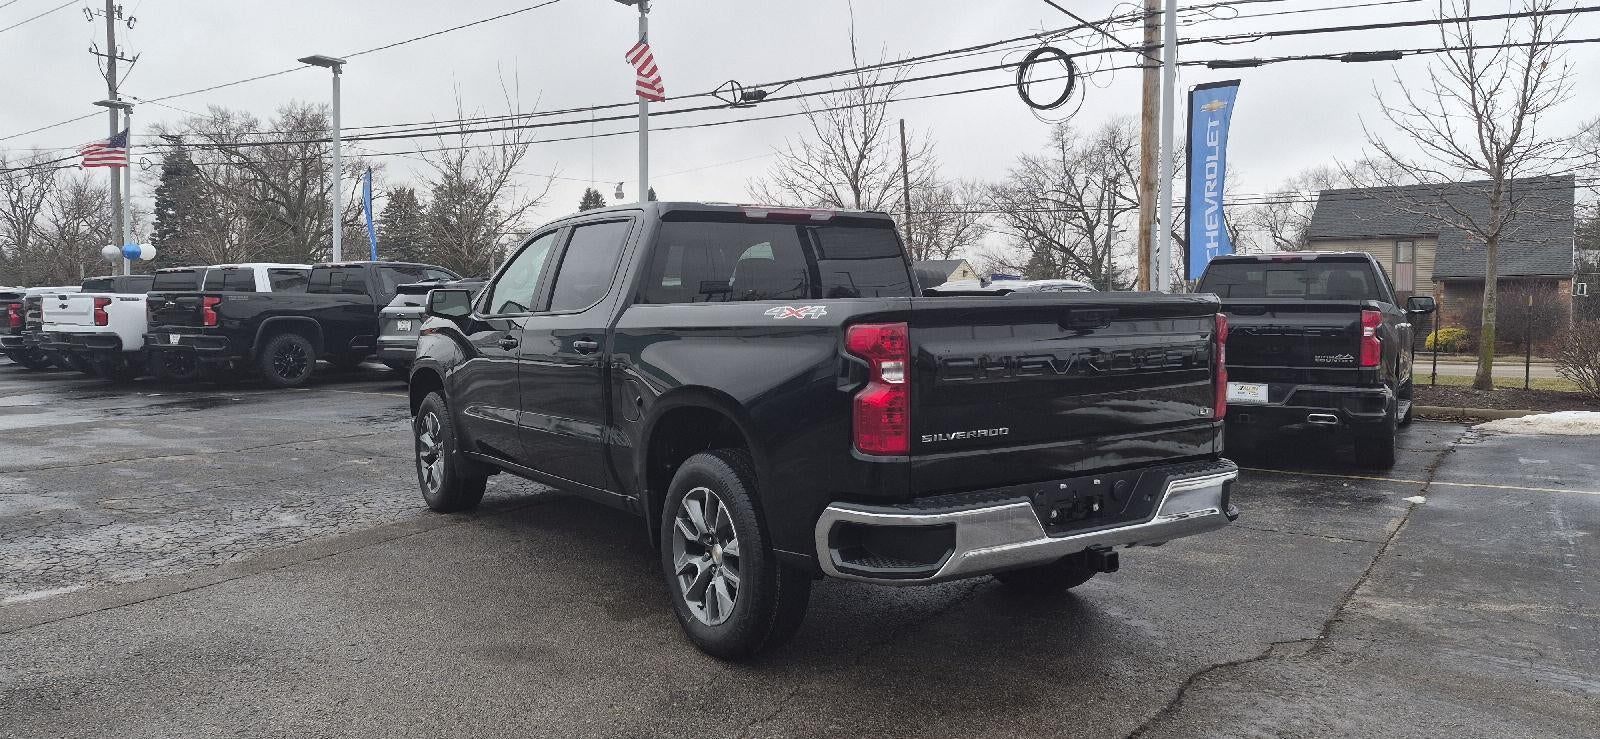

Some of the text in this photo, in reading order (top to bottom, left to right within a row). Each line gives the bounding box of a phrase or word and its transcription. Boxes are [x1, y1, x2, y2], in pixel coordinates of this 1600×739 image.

[1204, 117, 1220, 262] CHEVROLET
[939, 346, 1209, 381] CHEVROLET
[921, 427, 1010, 444] SILVERADO
